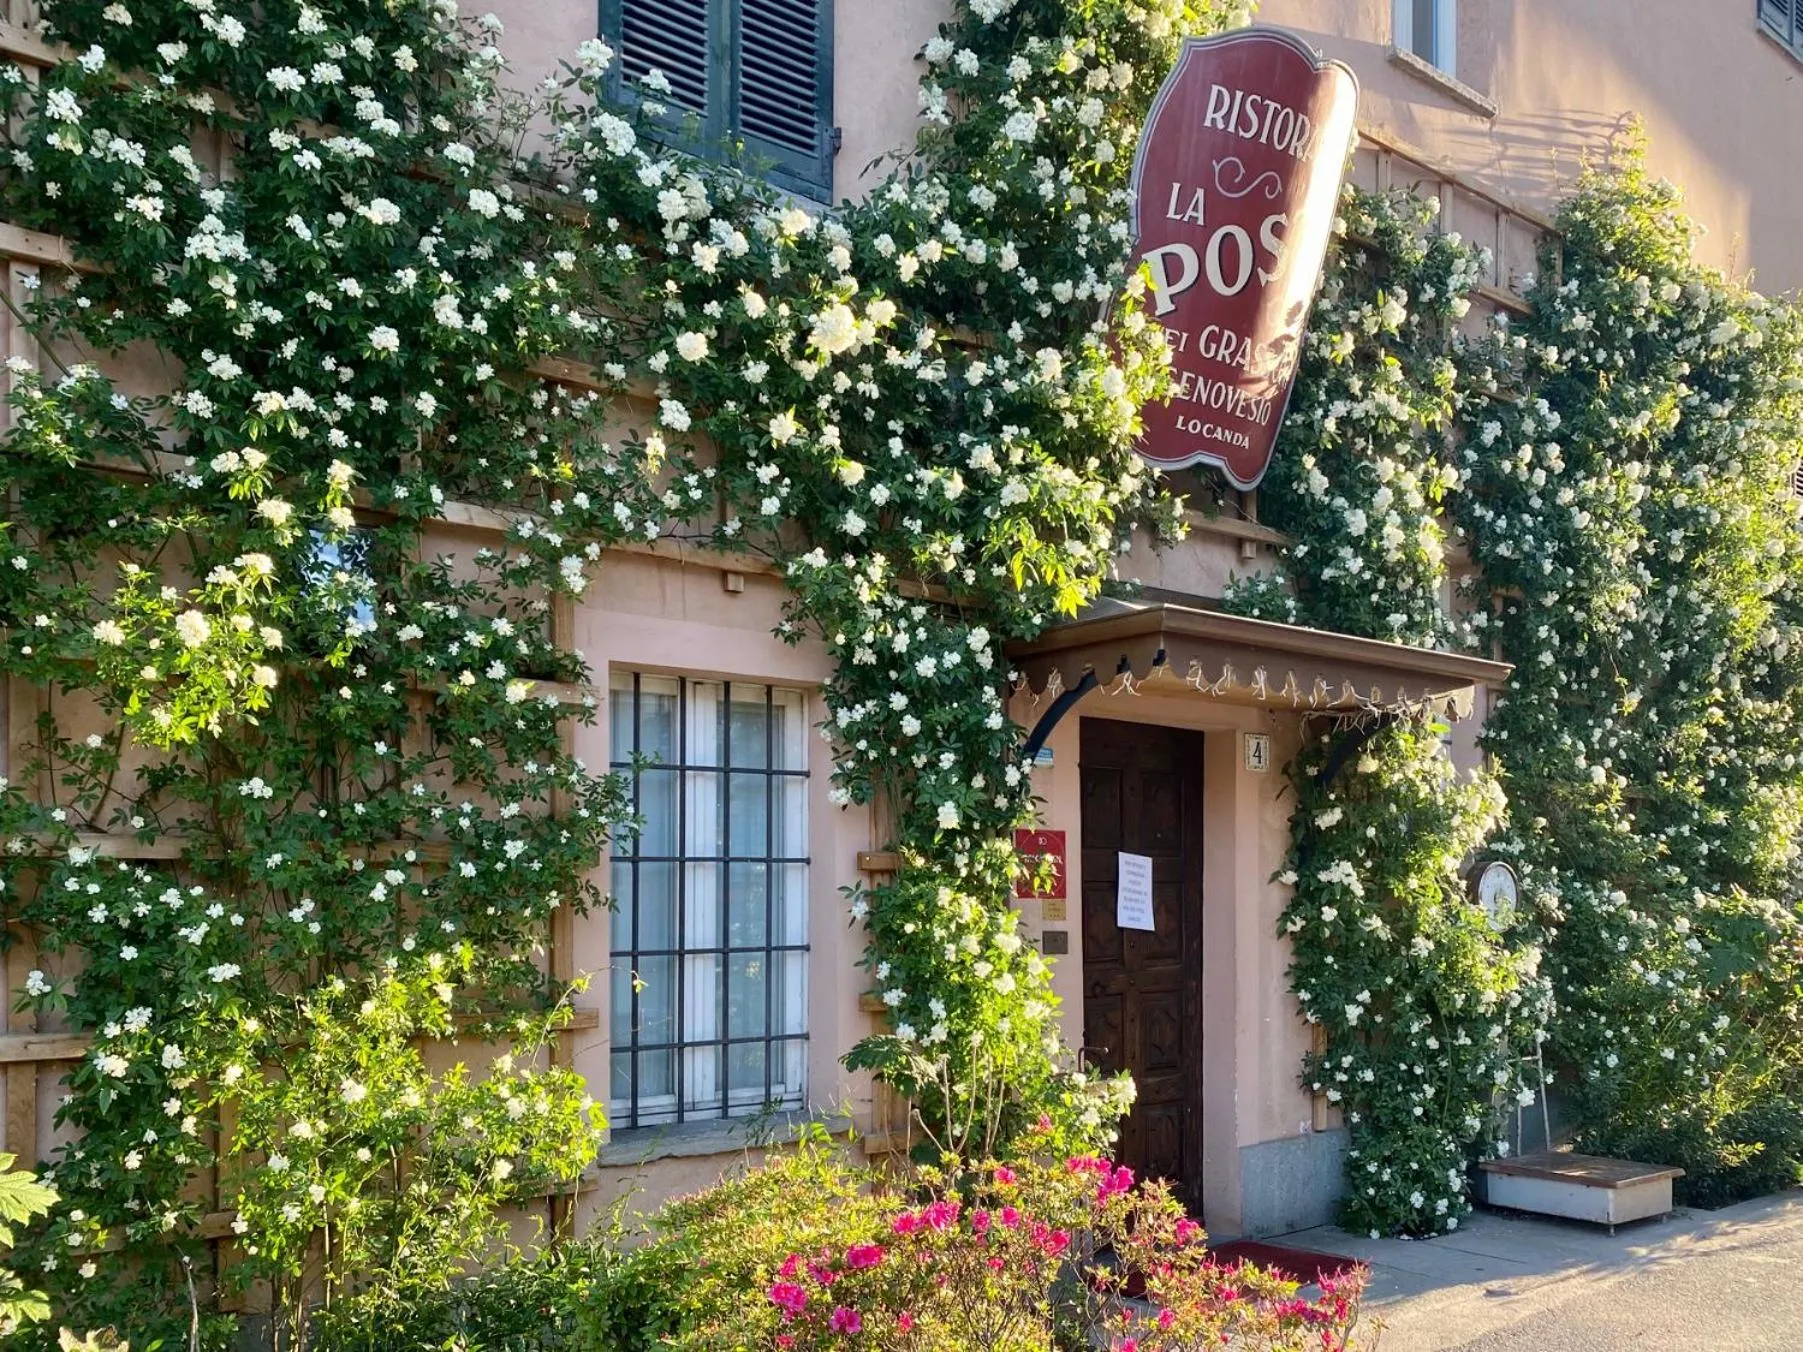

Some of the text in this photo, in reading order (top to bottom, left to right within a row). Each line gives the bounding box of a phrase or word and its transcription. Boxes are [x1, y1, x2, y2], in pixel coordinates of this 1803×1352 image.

[1166, 181, 1205, 226] LA
[1141, 213, 1289, 316] POS
[1164, 327, 1190, 352] EI
[1175, 415, 1250, 449] LOCANDA
[1252, 742, 1262, 765] 4
